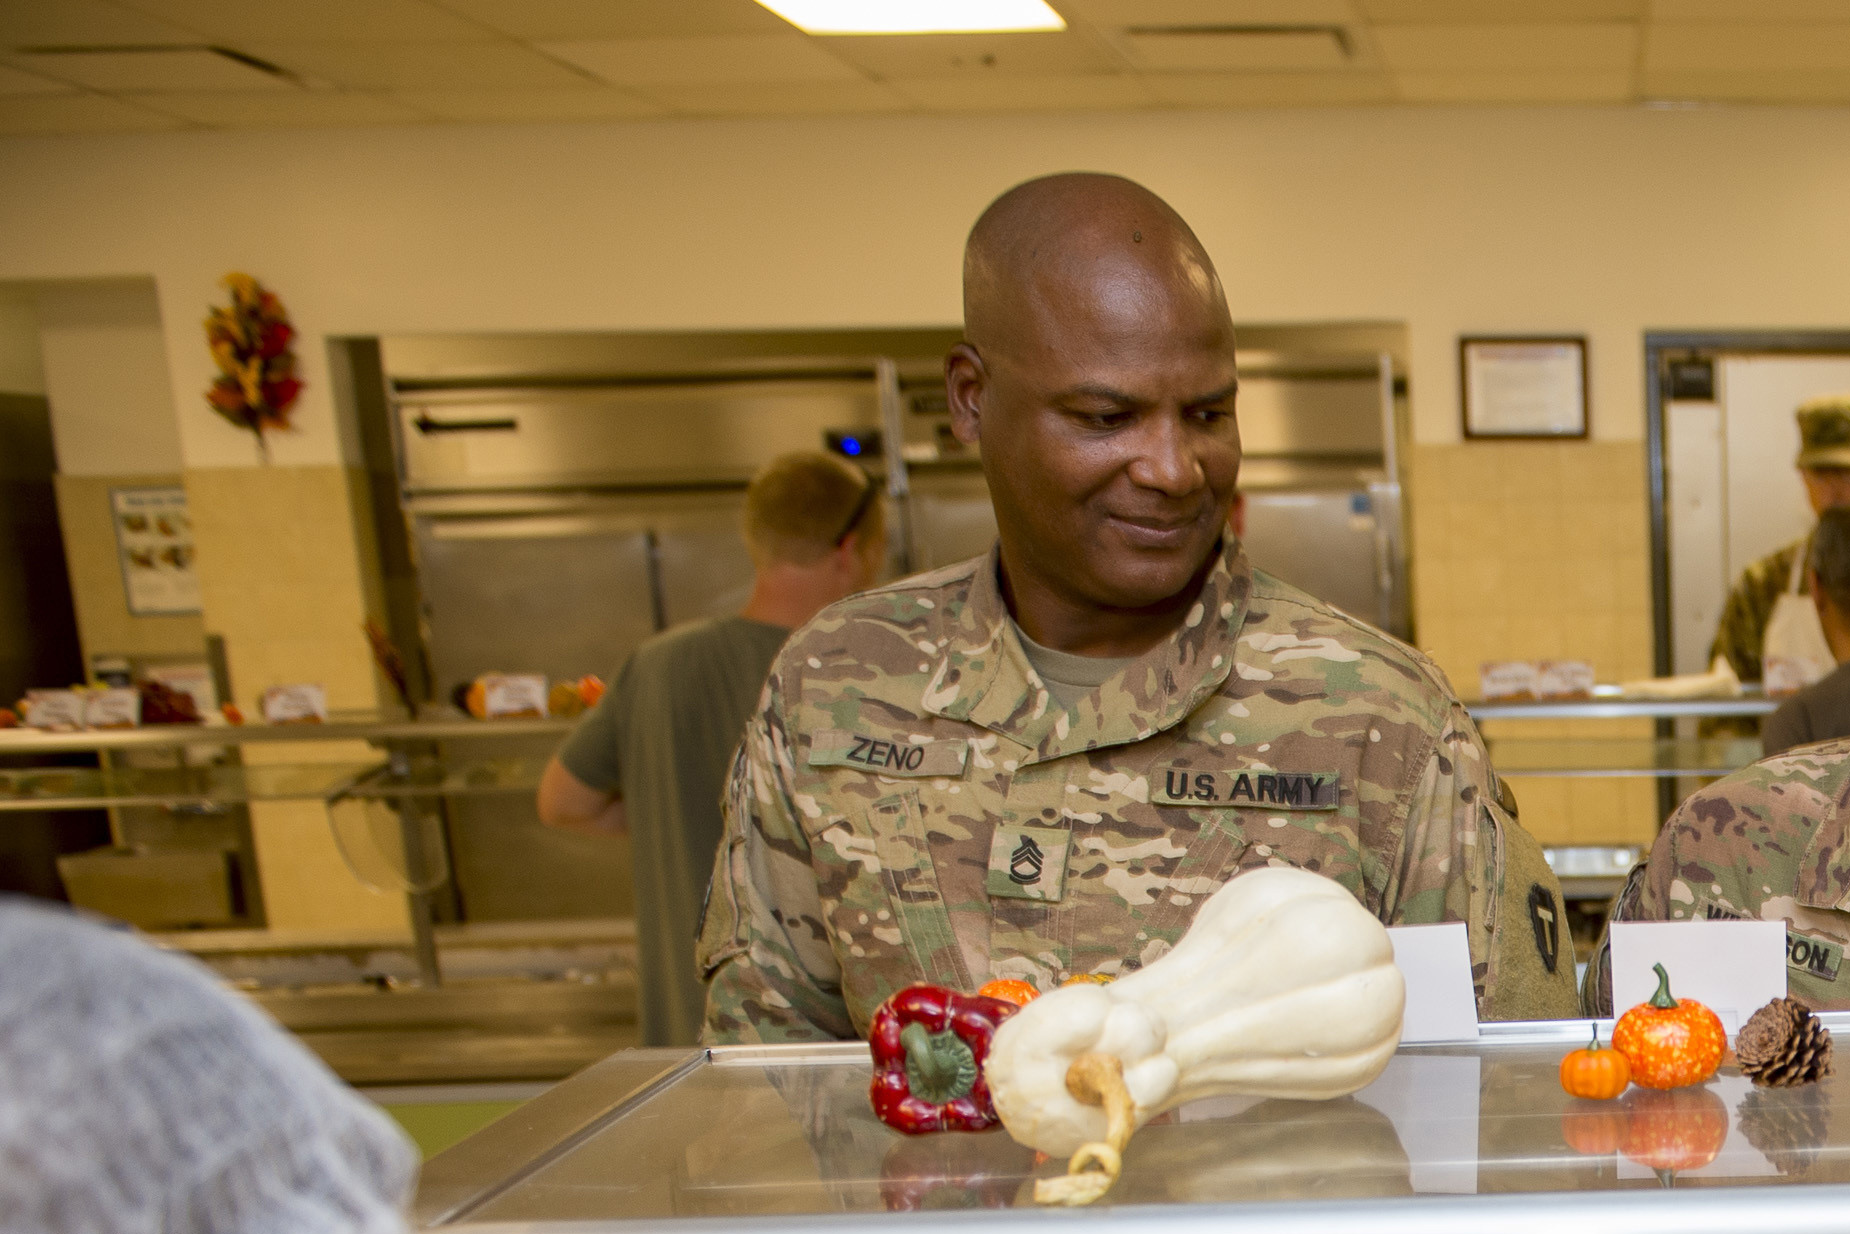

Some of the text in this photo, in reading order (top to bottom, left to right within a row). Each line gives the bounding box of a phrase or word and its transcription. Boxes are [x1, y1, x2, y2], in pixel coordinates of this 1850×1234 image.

[846, 735, 925, 771] ZENO
[1165, 770, 1326, 805] U.S. ARMY
